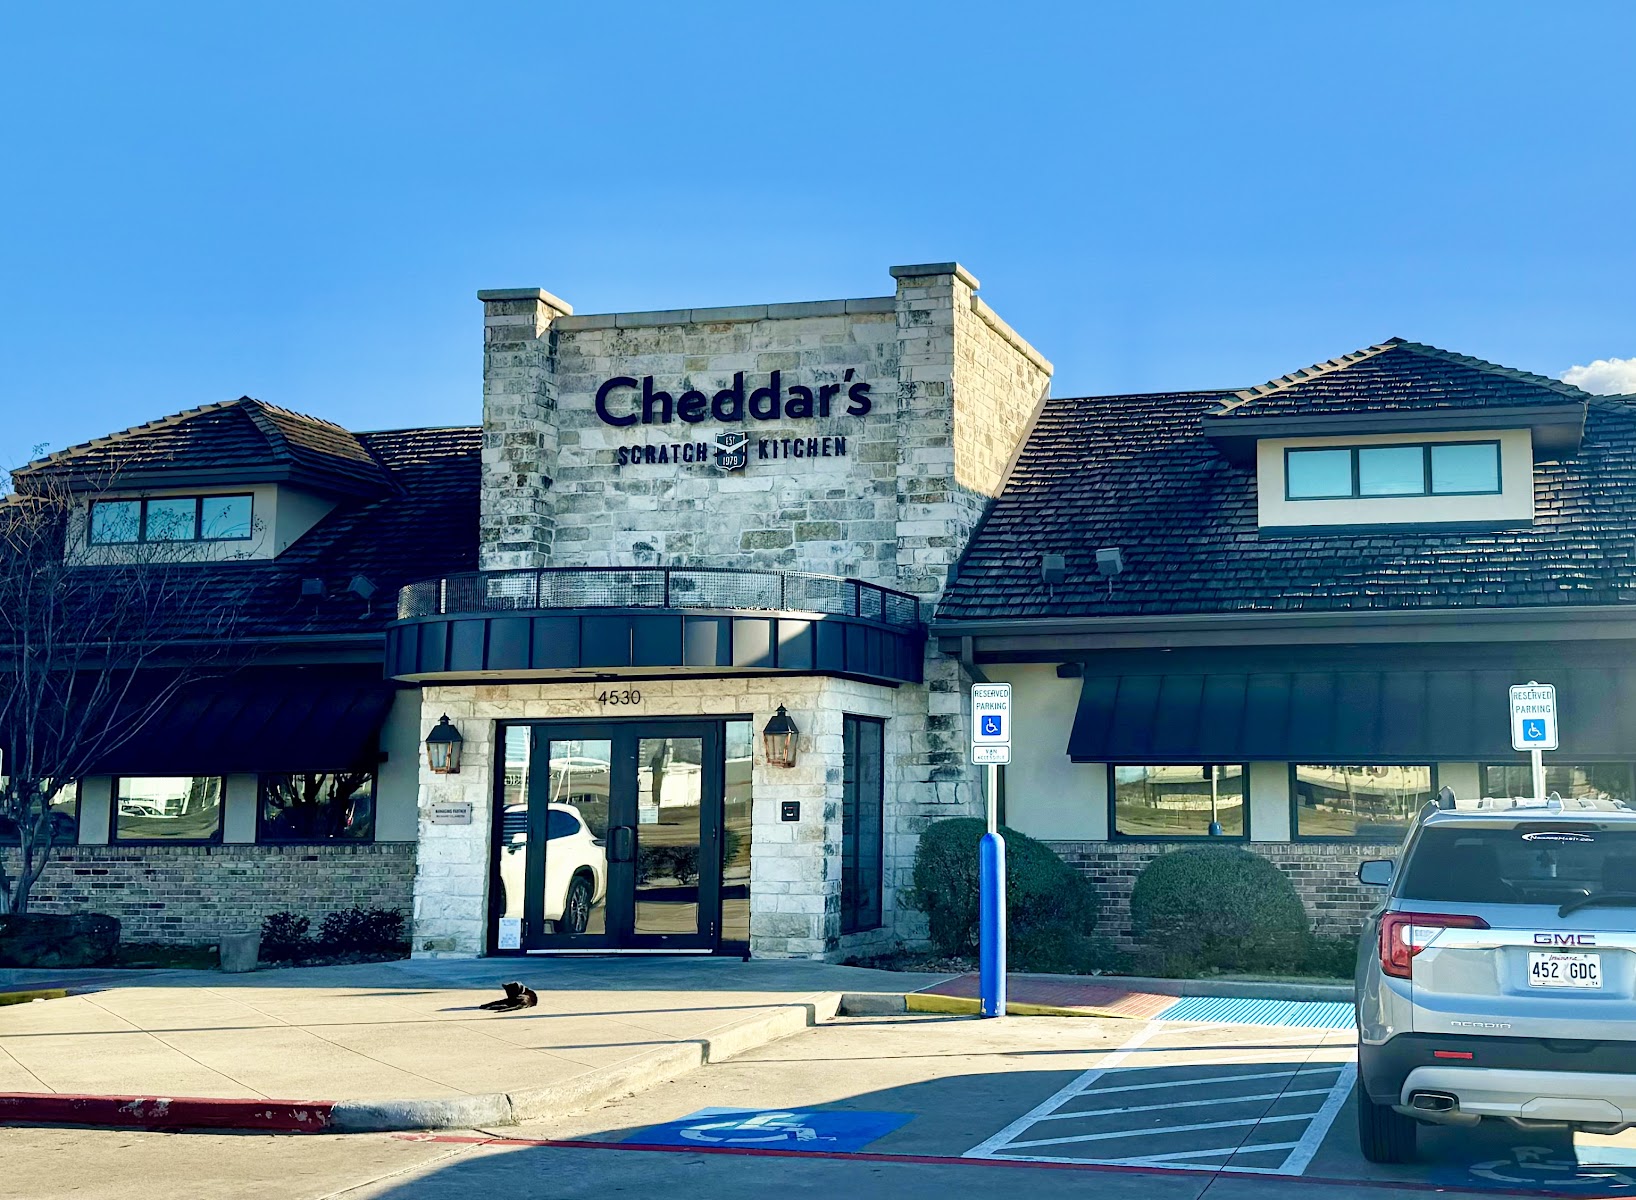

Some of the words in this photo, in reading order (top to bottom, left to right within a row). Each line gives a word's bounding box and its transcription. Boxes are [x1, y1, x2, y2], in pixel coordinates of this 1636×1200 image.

[595, 368, 872, 427] Cheddar's
[725, 435, 736, 446] EST
[618, 442, 708, 466] SCRATCH
[758, 436, 848, 460] KITCHEN
[598, 690, 641, 706] 4530
[974, 689, 1009, 698] RESERVED
[1513, 691, 1552, 701] RESERVED
[976, 702, 1007, 710] PARKING
[1515, 704, 1551, 714] PARKING
[1533, 933, 1596, 946] GMC
[1532, 962, 1559, 978] 452
[1570, 963, 1597, 980] GDC
[1450, 1021, 1512, 1029] ACADIA
